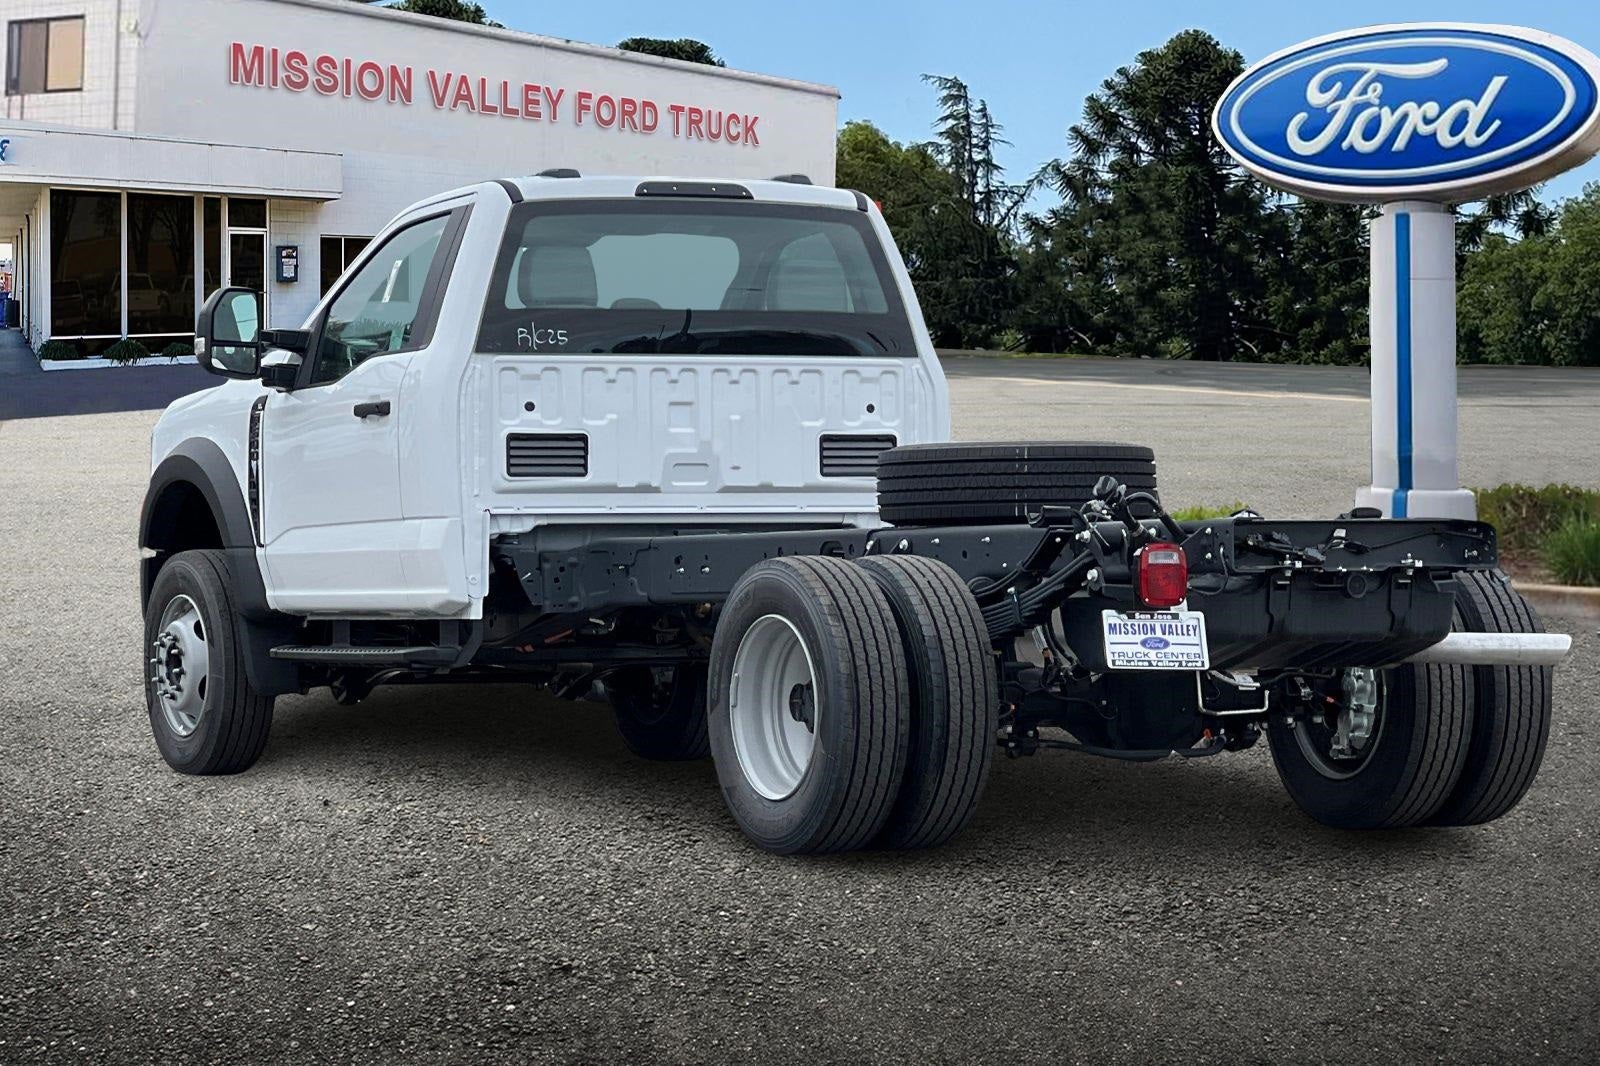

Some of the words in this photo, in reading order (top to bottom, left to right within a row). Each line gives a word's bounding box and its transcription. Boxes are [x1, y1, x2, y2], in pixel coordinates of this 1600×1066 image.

[229, 41, 413, 106] MISSION
[427, 68, 565, 123] VALLEY
[575, 90, 659, 134] FORD
[669, 102, 761, 146] TRUCK
[1286, 57, 1509, 156] Ford
[1134, 612, 1151, 620] San
[1153, 612, 1172, 620] Jose
[1108, 622, 1157, 636] MISSION
[1160, 623, 1198, 637] VALLEY
[1145, 638, 1165, 648] Ford
[1111, 651, 1151, 660] TRUCK
[1155, 651, 1201, 660] CENTER
[1151, 660, 1179, 668] Valley
